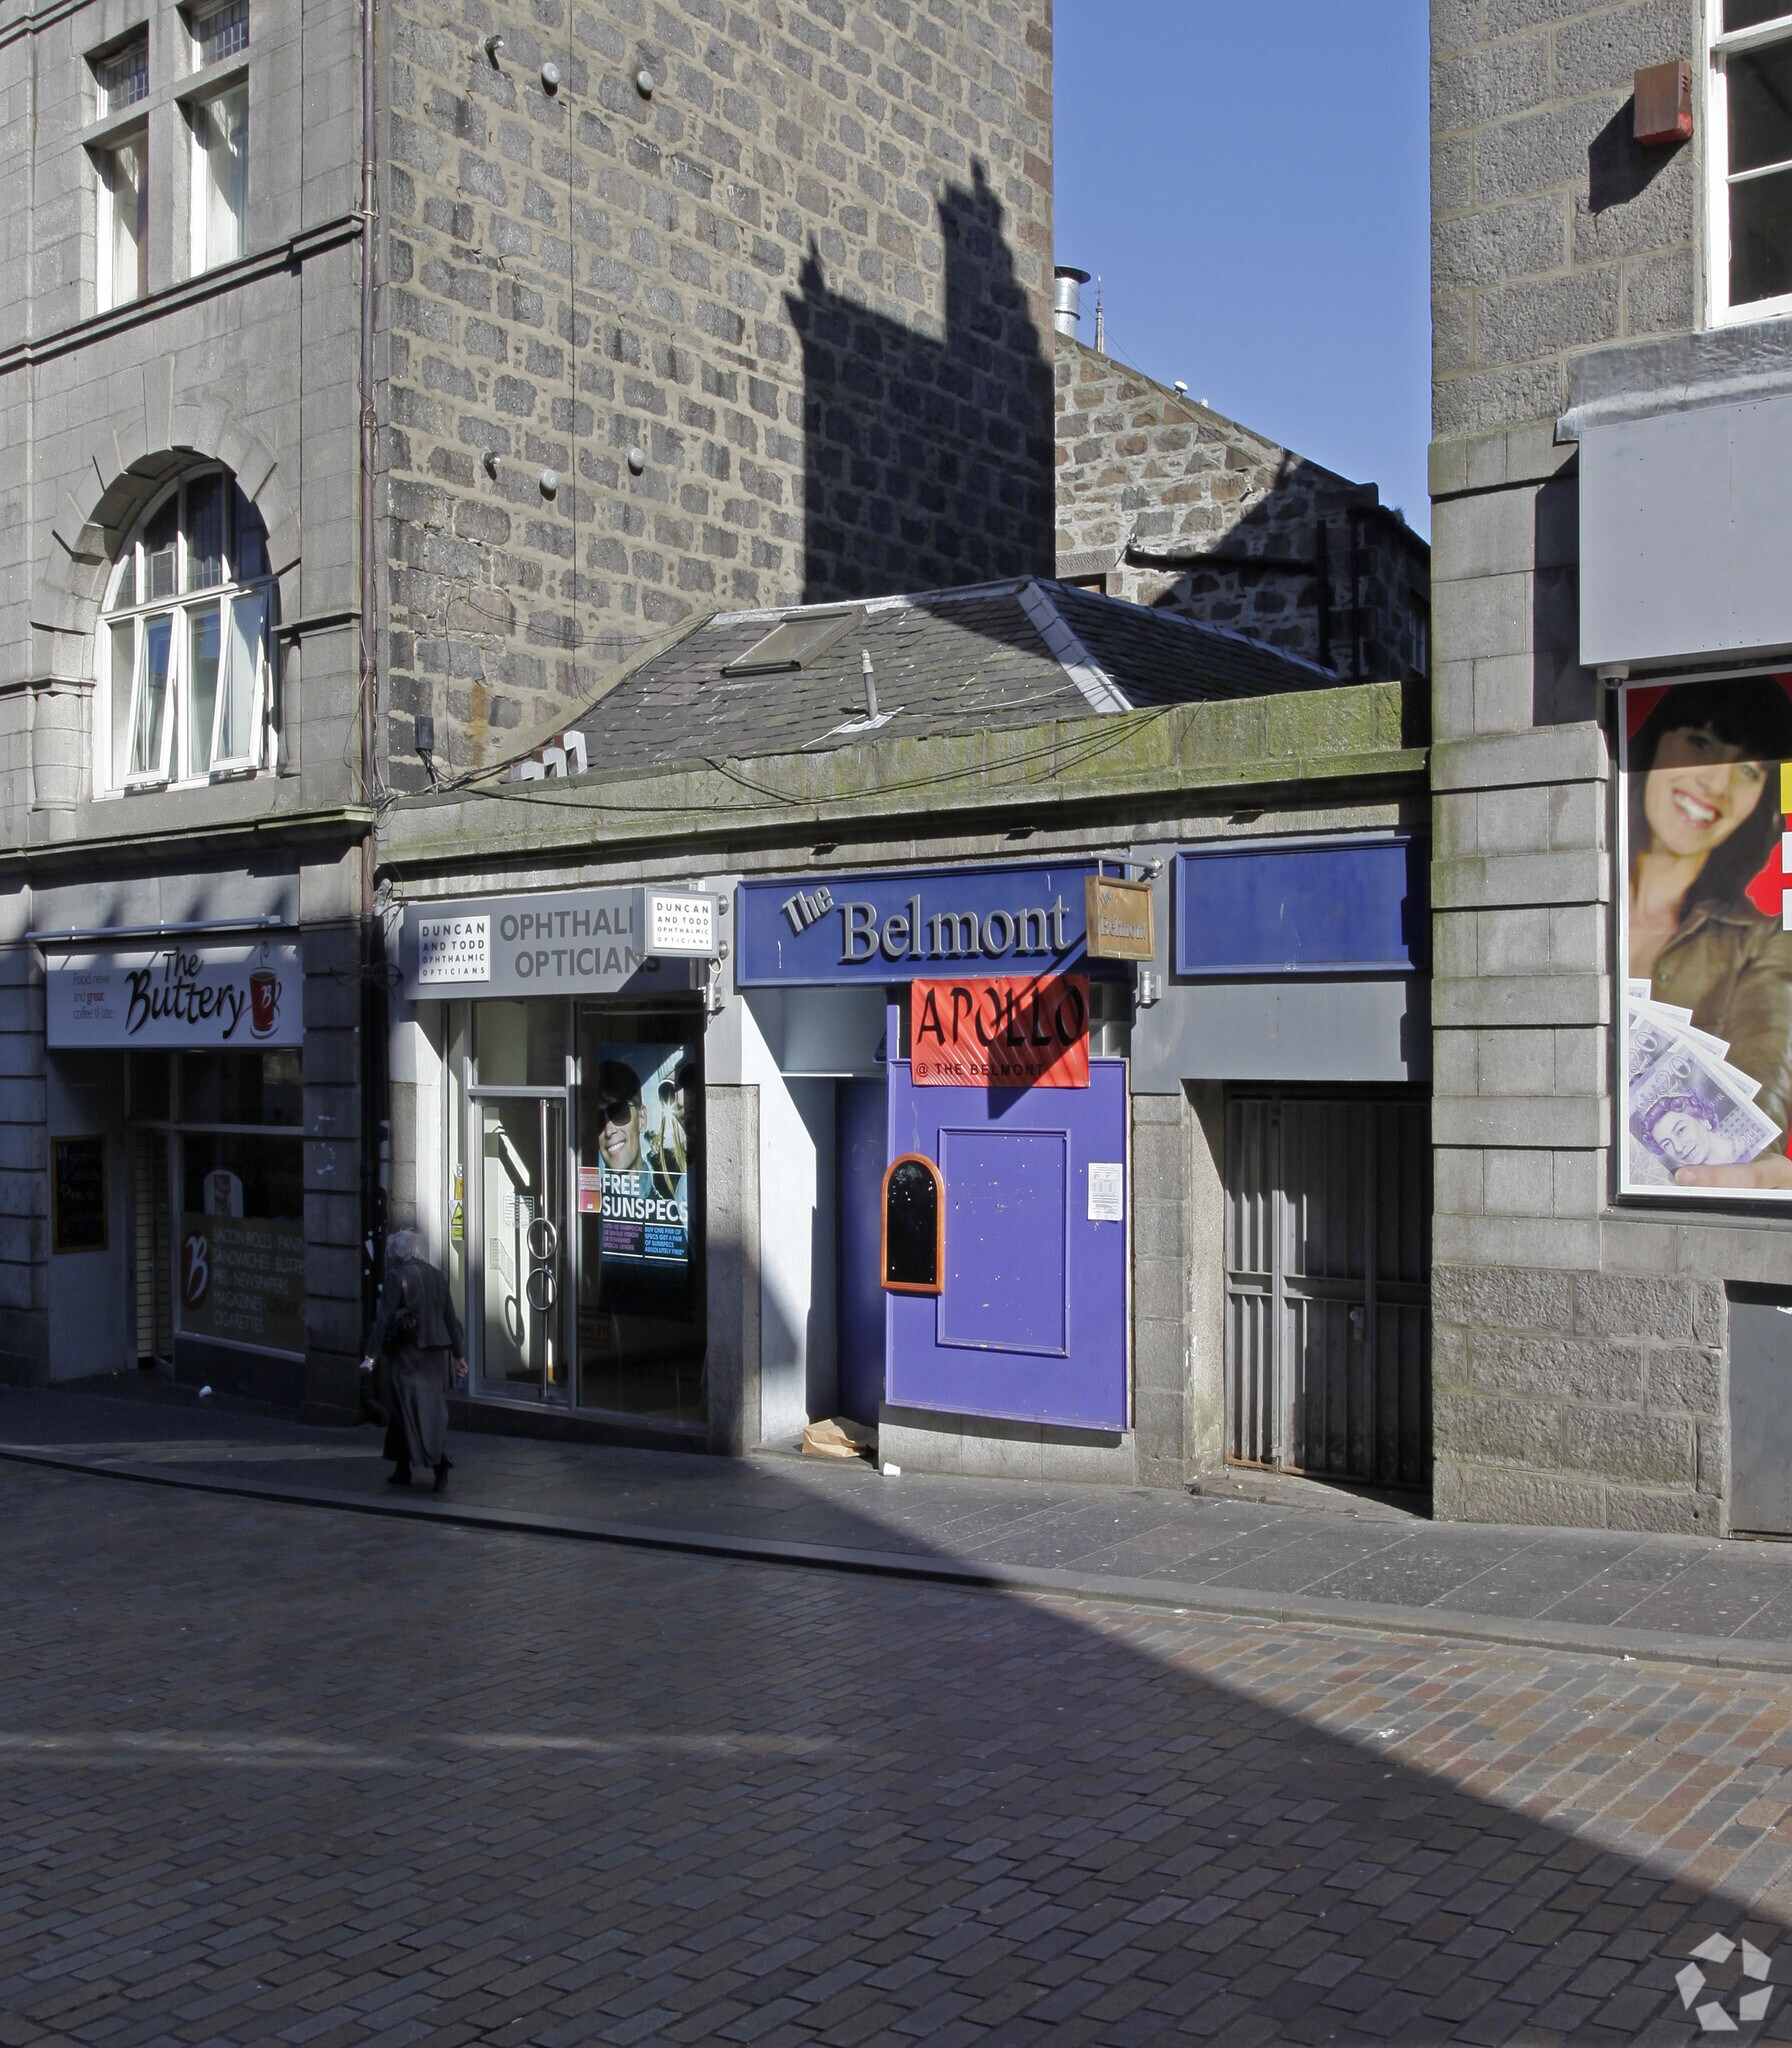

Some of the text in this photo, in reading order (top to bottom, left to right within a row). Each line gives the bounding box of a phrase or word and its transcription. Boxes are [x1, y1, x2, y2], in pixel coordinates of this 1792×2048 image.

[657, 902, 709, 914] DUNCAN
[781, 885, 835, 933] The
[422, 923, 485, 937] DUNCAN
[500, 906, 633, 942] OPHTHAL
[657, 916, 709, 926] AND TODD
[657, 926, 709, 935] OPHTHALMIC
[840, 893, 1071, 961] Belmont
[1100, 913, 1147, 940] Belmont
[423, 940, 485, 951] AND TODD
[163, 946, 204, 981] The
[422, 953, 485, 964] OPHTHALMIC
[515, 946, 661, 978] OPTICIANS
[422, 967, 485, 976] OPTICIANS
[73, 990, 105, 1006] and great
[124, 968, 245, 1039] Buttery
[916, 984, 1085, 1047] APOLLO
[916, 1062, 1044, 1077] @ THE BELMONT
[602, 1173, 640, 1196] FREE
[602, 1196, 688, 1222] SUNSPECS
[246, 1231, 272, 1248] ROLLS
[644, 1246, 672, 1254] ABSOLUTELY
[652, 1240, 674, 1248] SUNSPECS
[185, 1234, 208, 1302] B
[213, 1248, 270, 1270] SANDWICHES
[213, 1269, 289, 1295] PIES NEWSPAPERS
[213, 1288, 264, 1312] MAGAZINES
[214, 1310, 264, 1333] CIGARETTES
